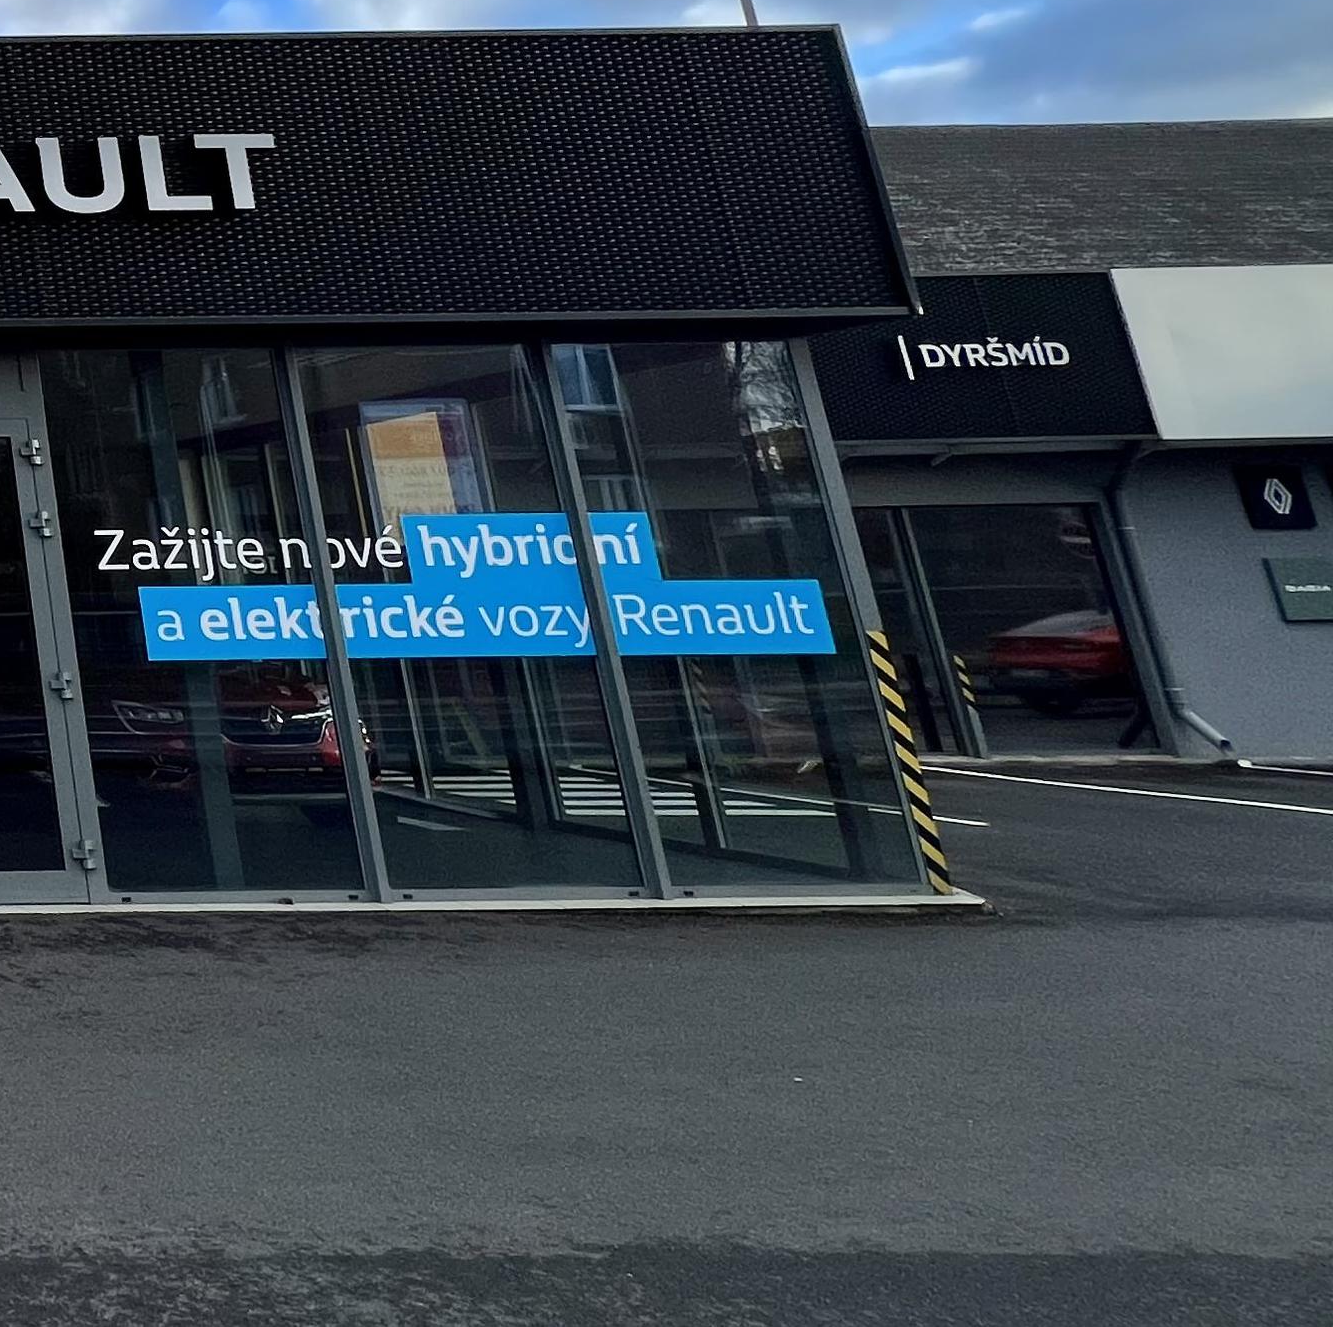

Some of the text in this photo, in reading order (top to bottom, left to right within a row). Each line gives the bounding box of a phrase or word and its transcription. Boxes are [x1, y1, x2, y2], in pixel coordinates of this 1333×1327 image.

[918, 335, 1070, 368] DYRŠMÍD
[94, 525, 265, 581] Zažijte
[282, 525, 404, 570] nové
[157, 591, 815, 648] a elektrické vozy Renault
